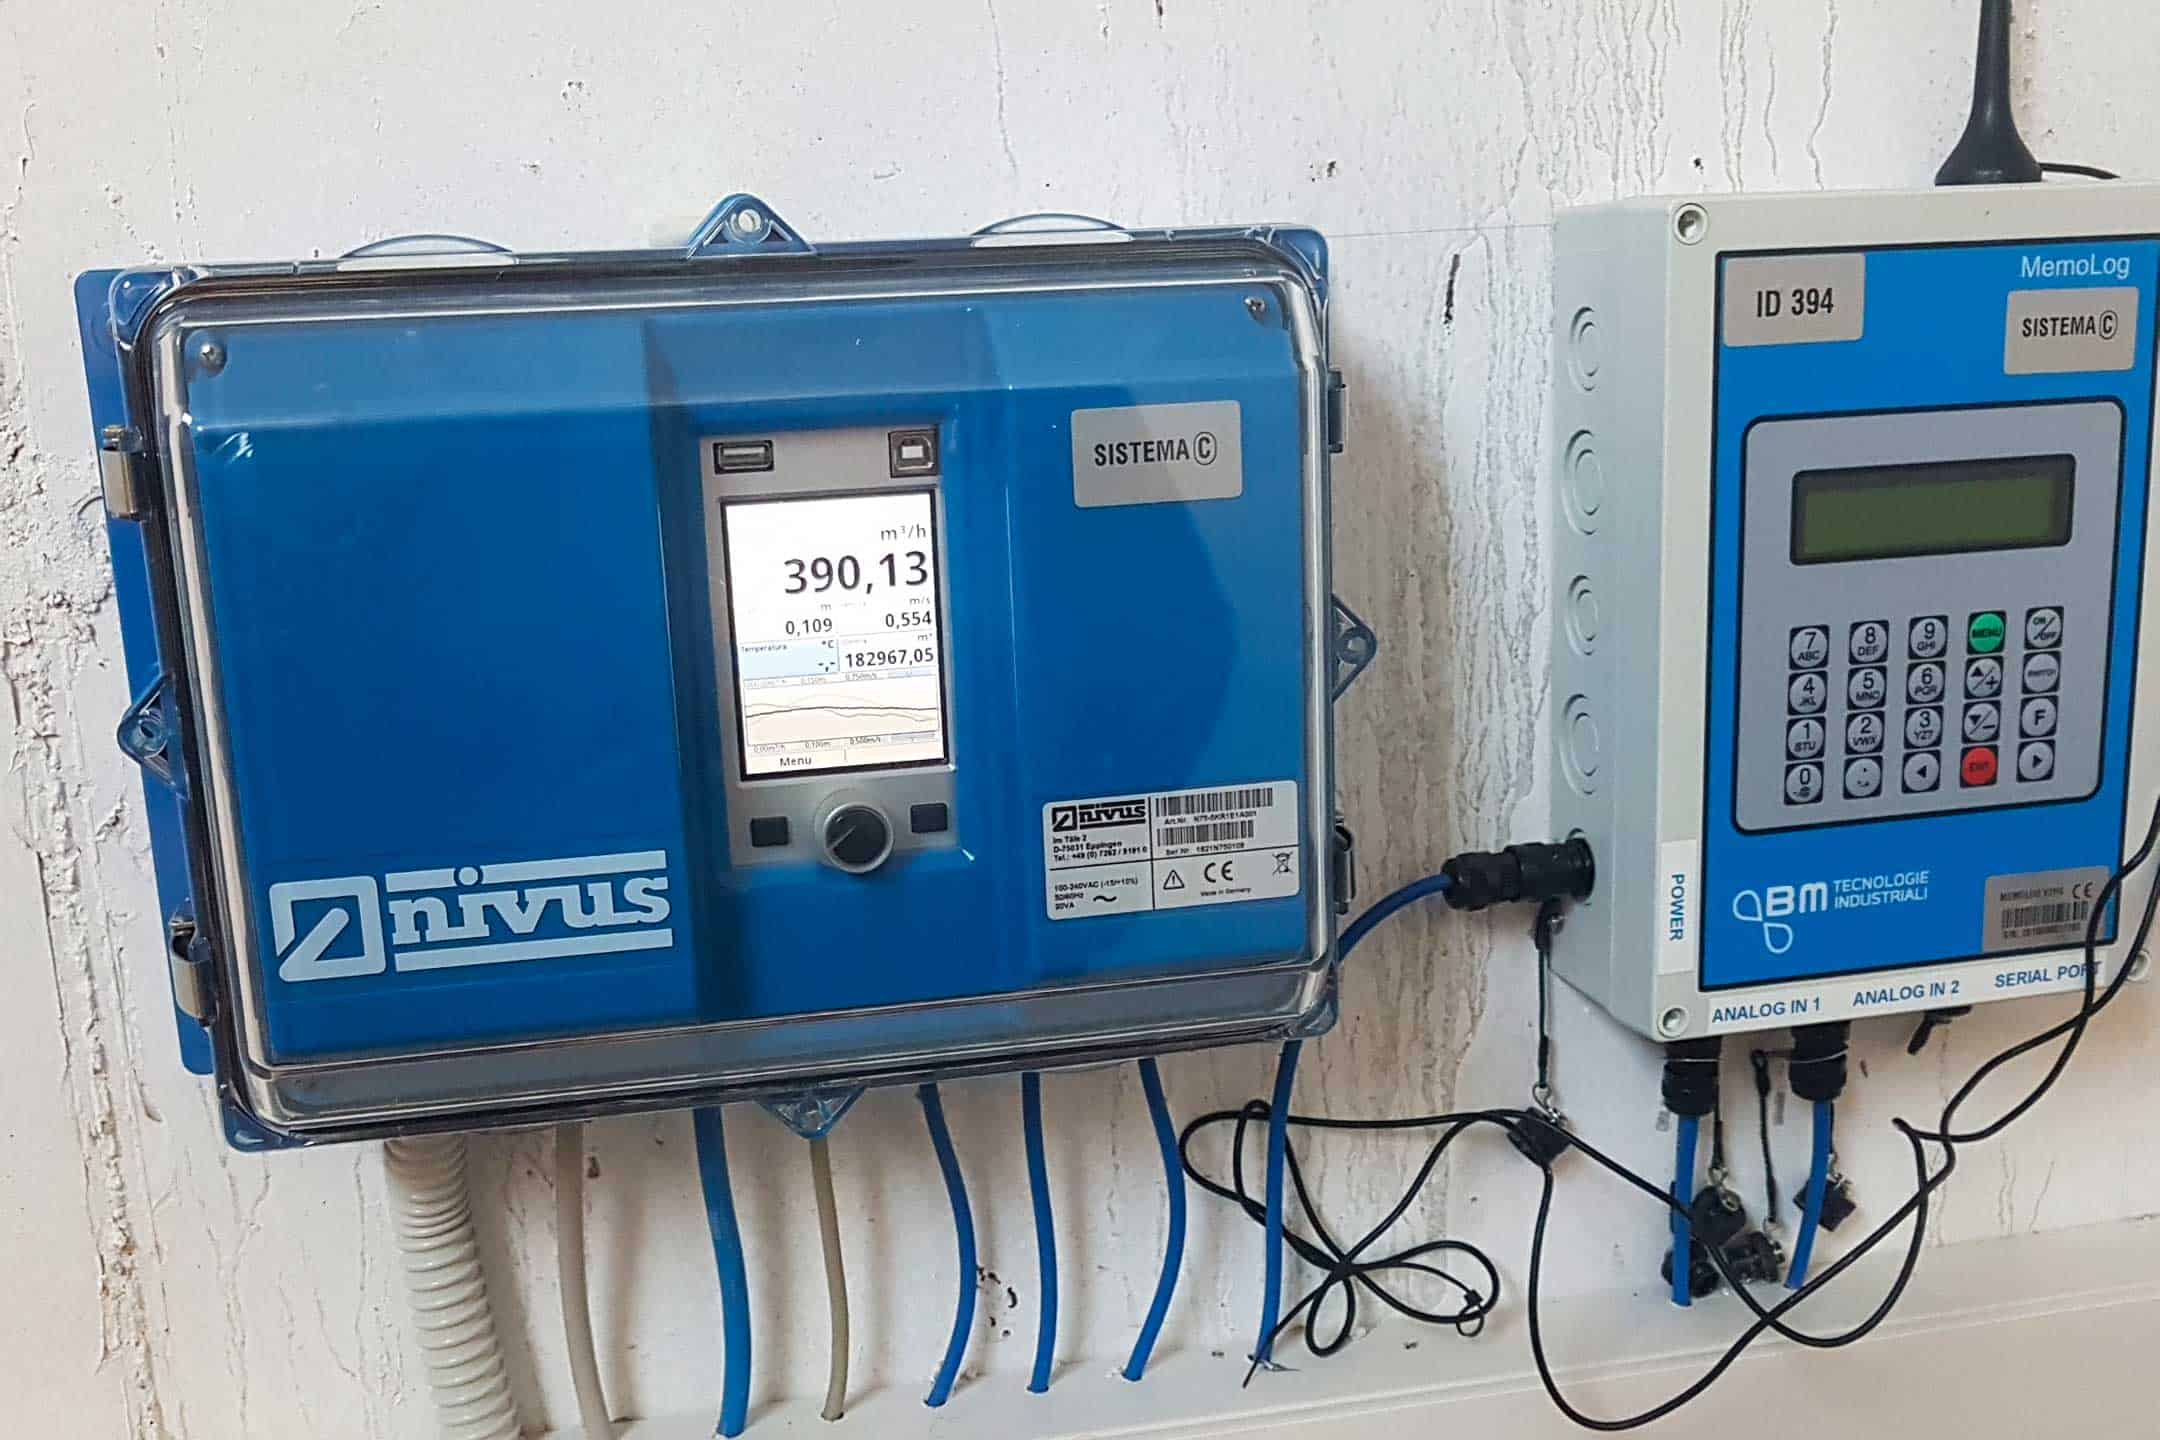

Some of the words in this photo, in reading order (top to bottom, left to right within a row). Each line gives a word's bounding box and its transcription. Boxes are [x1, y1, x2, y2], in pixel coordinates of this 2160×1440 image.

[2020, 254, 2130, 280] MemoLog
[1757, 290, 1781, 318] ID
[1791, 287, 1834, 315] 394
[784, 551, 928, 594] 390,13
[786, 617, 833, 637] 0,109
[885, 610, 932, 629] 0,554
[1864, 626, 1876, 644] 8
[1924, 622, 1936, 639] 9
[1805, 632, 1817, 649] 7
[1916, 640, 1936, 651] GHI
[845, 648, 934, 668] 182967,05
[1798, 650, 1820, 661] ABC
[1857, 645, 1879, 656] DEF
[1863, 672, 1874, 689] 5
[1921, 667, 1933, 685] 6
[1803, 677, 1815, 695] 4
[1856, 691, 1880, 701] MNO
[1860, 716, 1872, 734] 2
[1920, 711, 1930, 728] 3
[2034, 709, 2046, 726] F
[1803, 722, 1811, 740] 1
[780, 757, 812, 767] Menu
[1799, 768, 1811, 785] 0
[1079, 802, 1146, 823] nivus
[1833, 870, 1929, 893] TECNOLOGIE
[388, 866, 671, 945] nivus
[1669, 873, 1685, 941] POWER
[1834, 888, 1928, 910] INDUSTRIALI
[1995, 968, 2053, 988] SERIAL
[1852, 984, 1925, 1007] ANALOG
[1930, 982, 1947, 996] IN
[1951, 980, 1960, 994] 2
[1712, 1002, 1785, 1024] ANALOG
[1791, 999, 1807, 1013] IN
[1814, 998, 1820, 1011] 1
